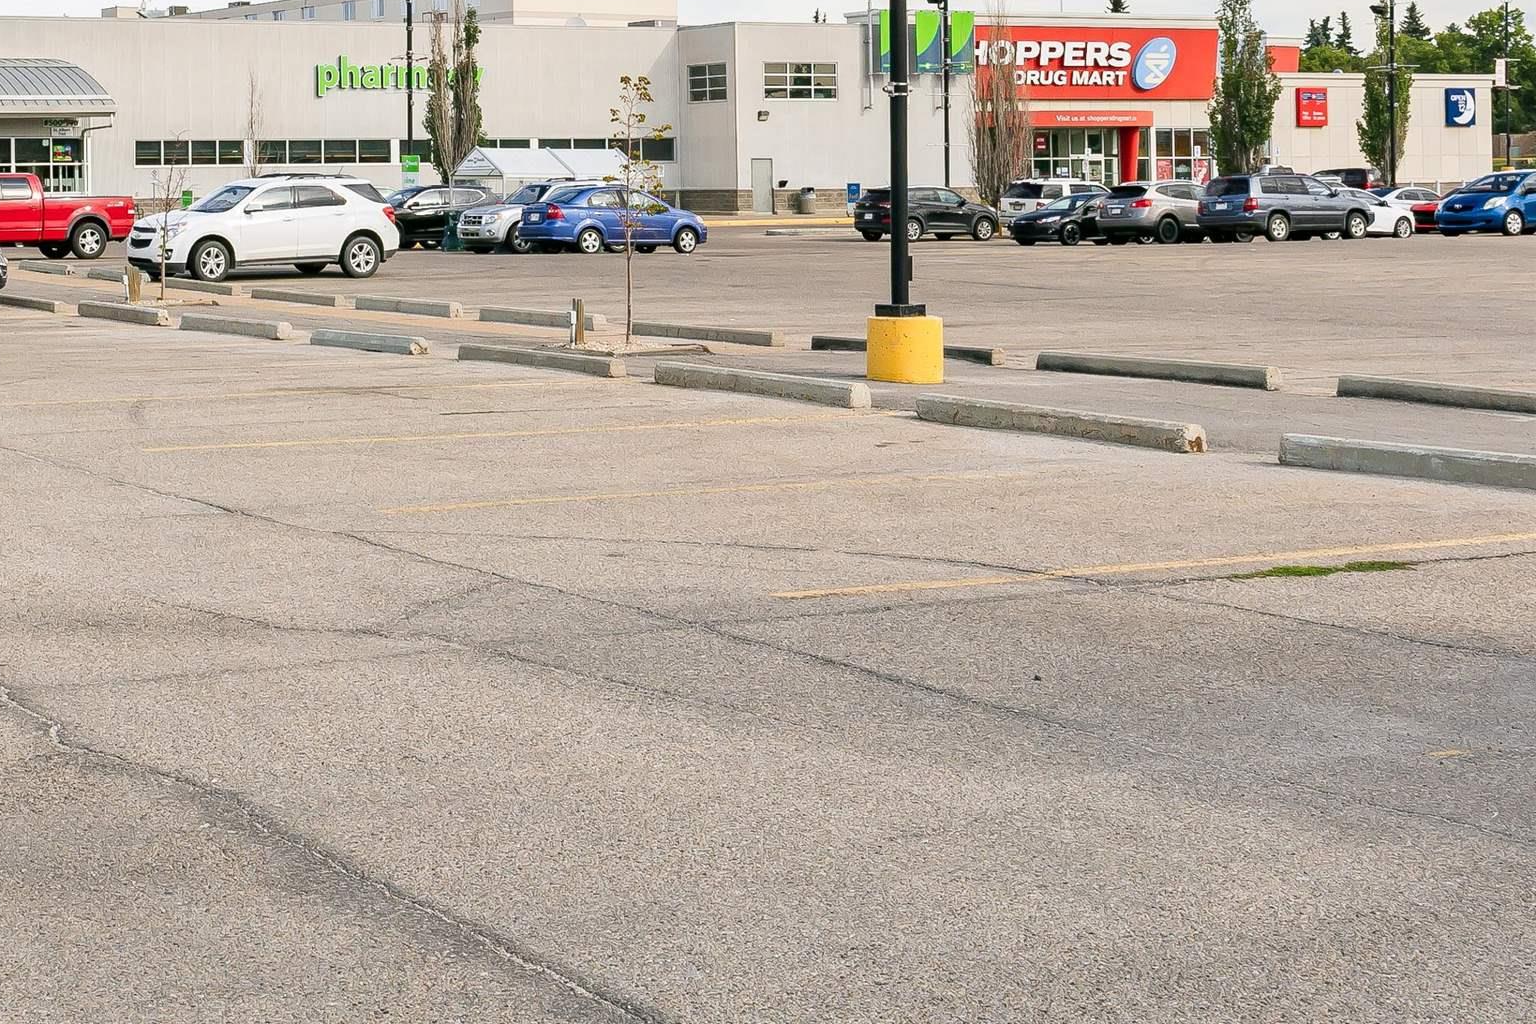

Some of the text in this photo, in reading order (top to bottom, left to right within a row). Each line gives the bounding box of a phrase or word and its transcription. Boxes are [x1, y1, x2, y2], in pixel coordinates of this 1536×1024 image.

[975, 40, 1132, 68] HOPPERS
[1014, 70, 1127, 86] DRUG MART
